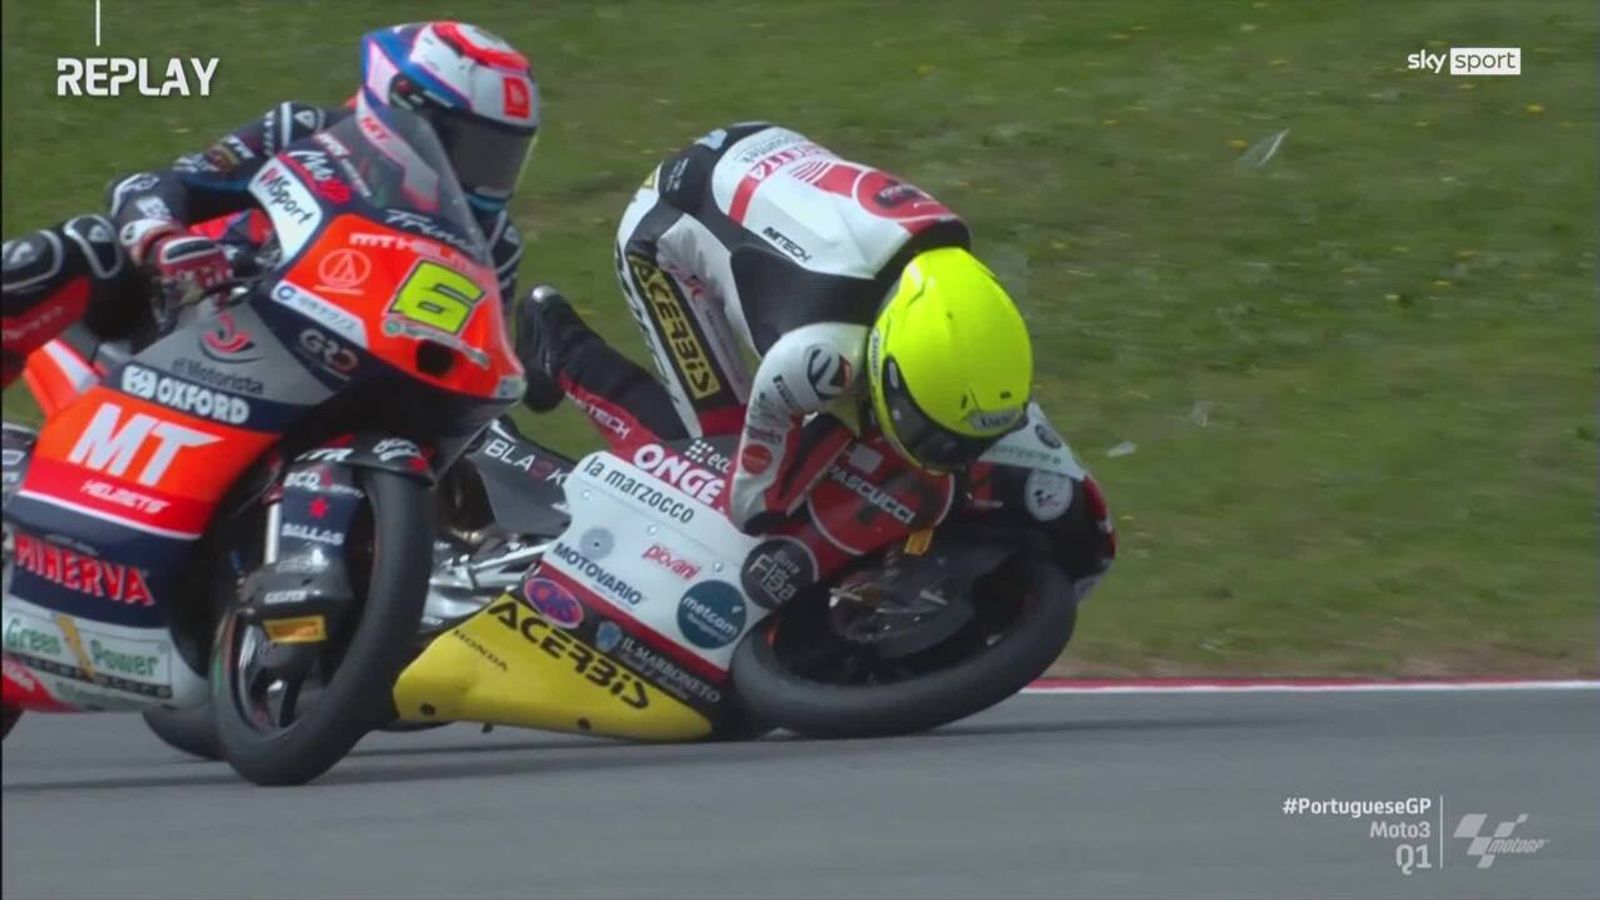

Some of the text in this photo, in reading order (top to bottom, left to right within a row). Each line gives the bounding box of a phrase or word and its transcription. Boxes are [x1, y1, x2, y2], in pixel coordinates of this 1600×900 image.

[391, 259, 485, 335] 6
[157, 377, 250, 424] OXFORD
[67, 402, 226, 488] MT
[633, 443, 726, 505] ONGE
[81, 480, 170, 514] HELMETS
[583, 456, 695, 525] la marzocco
[828, 466, 916, 525] PASCUCCI
[14, 533, 155, 607] MINERVA
[553, 541, 644, 606] MOTOVARIO
[641, 544, 702, 581] piovani
[5, 618, 160, 676] Green Power
[682, 596, 738, 638] metcam
[453, 629, 508, 672] HONDA
[488, 600, 650, 710] ACERBIS
